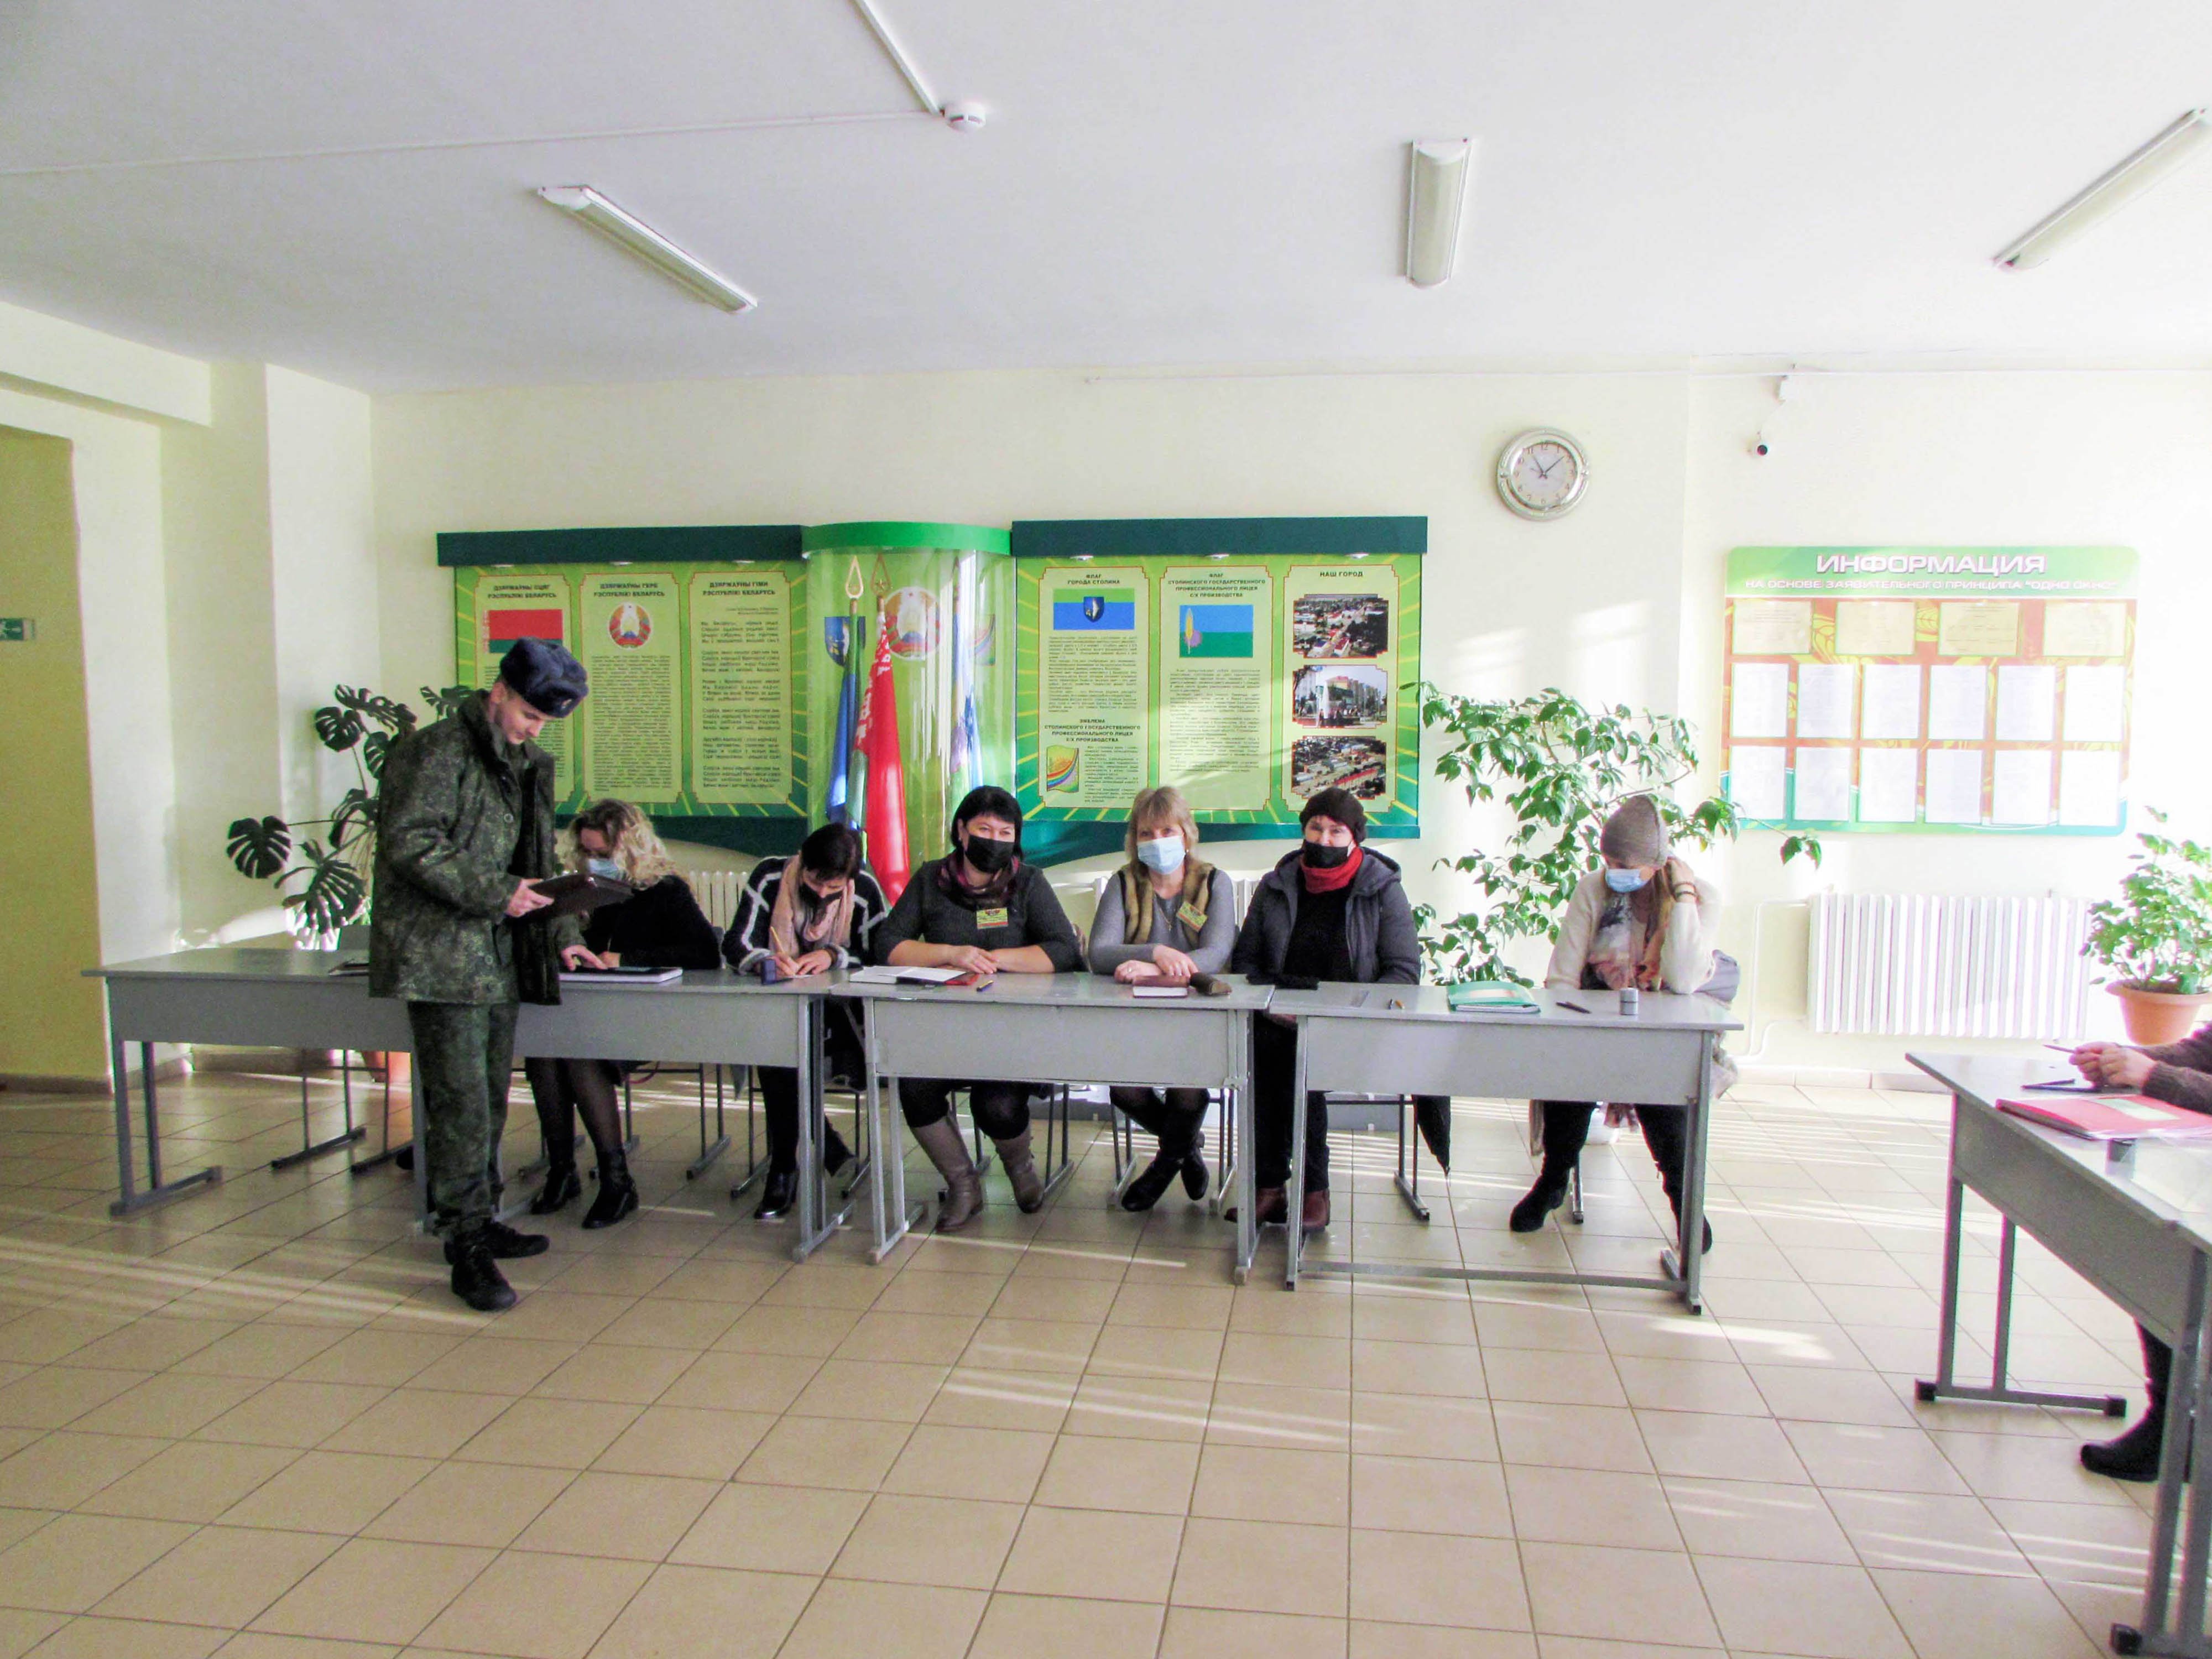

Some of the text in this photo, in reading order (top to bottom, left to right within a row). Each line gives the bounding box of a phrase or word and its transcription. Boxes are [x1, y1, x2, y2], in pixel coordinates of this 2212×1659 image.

[1817, 555, 2046, 577] ИНФОРМАЦИЯ
[1745, 580, 1766, 588] НА
[1767, 580, 1822, 588] ОСНОВЕ
[1827, 580, 1943, 589] ЗАЯВИТЕЛЬНОГО
[1945, 581, 2023, 590] ПРИНЦИПА
